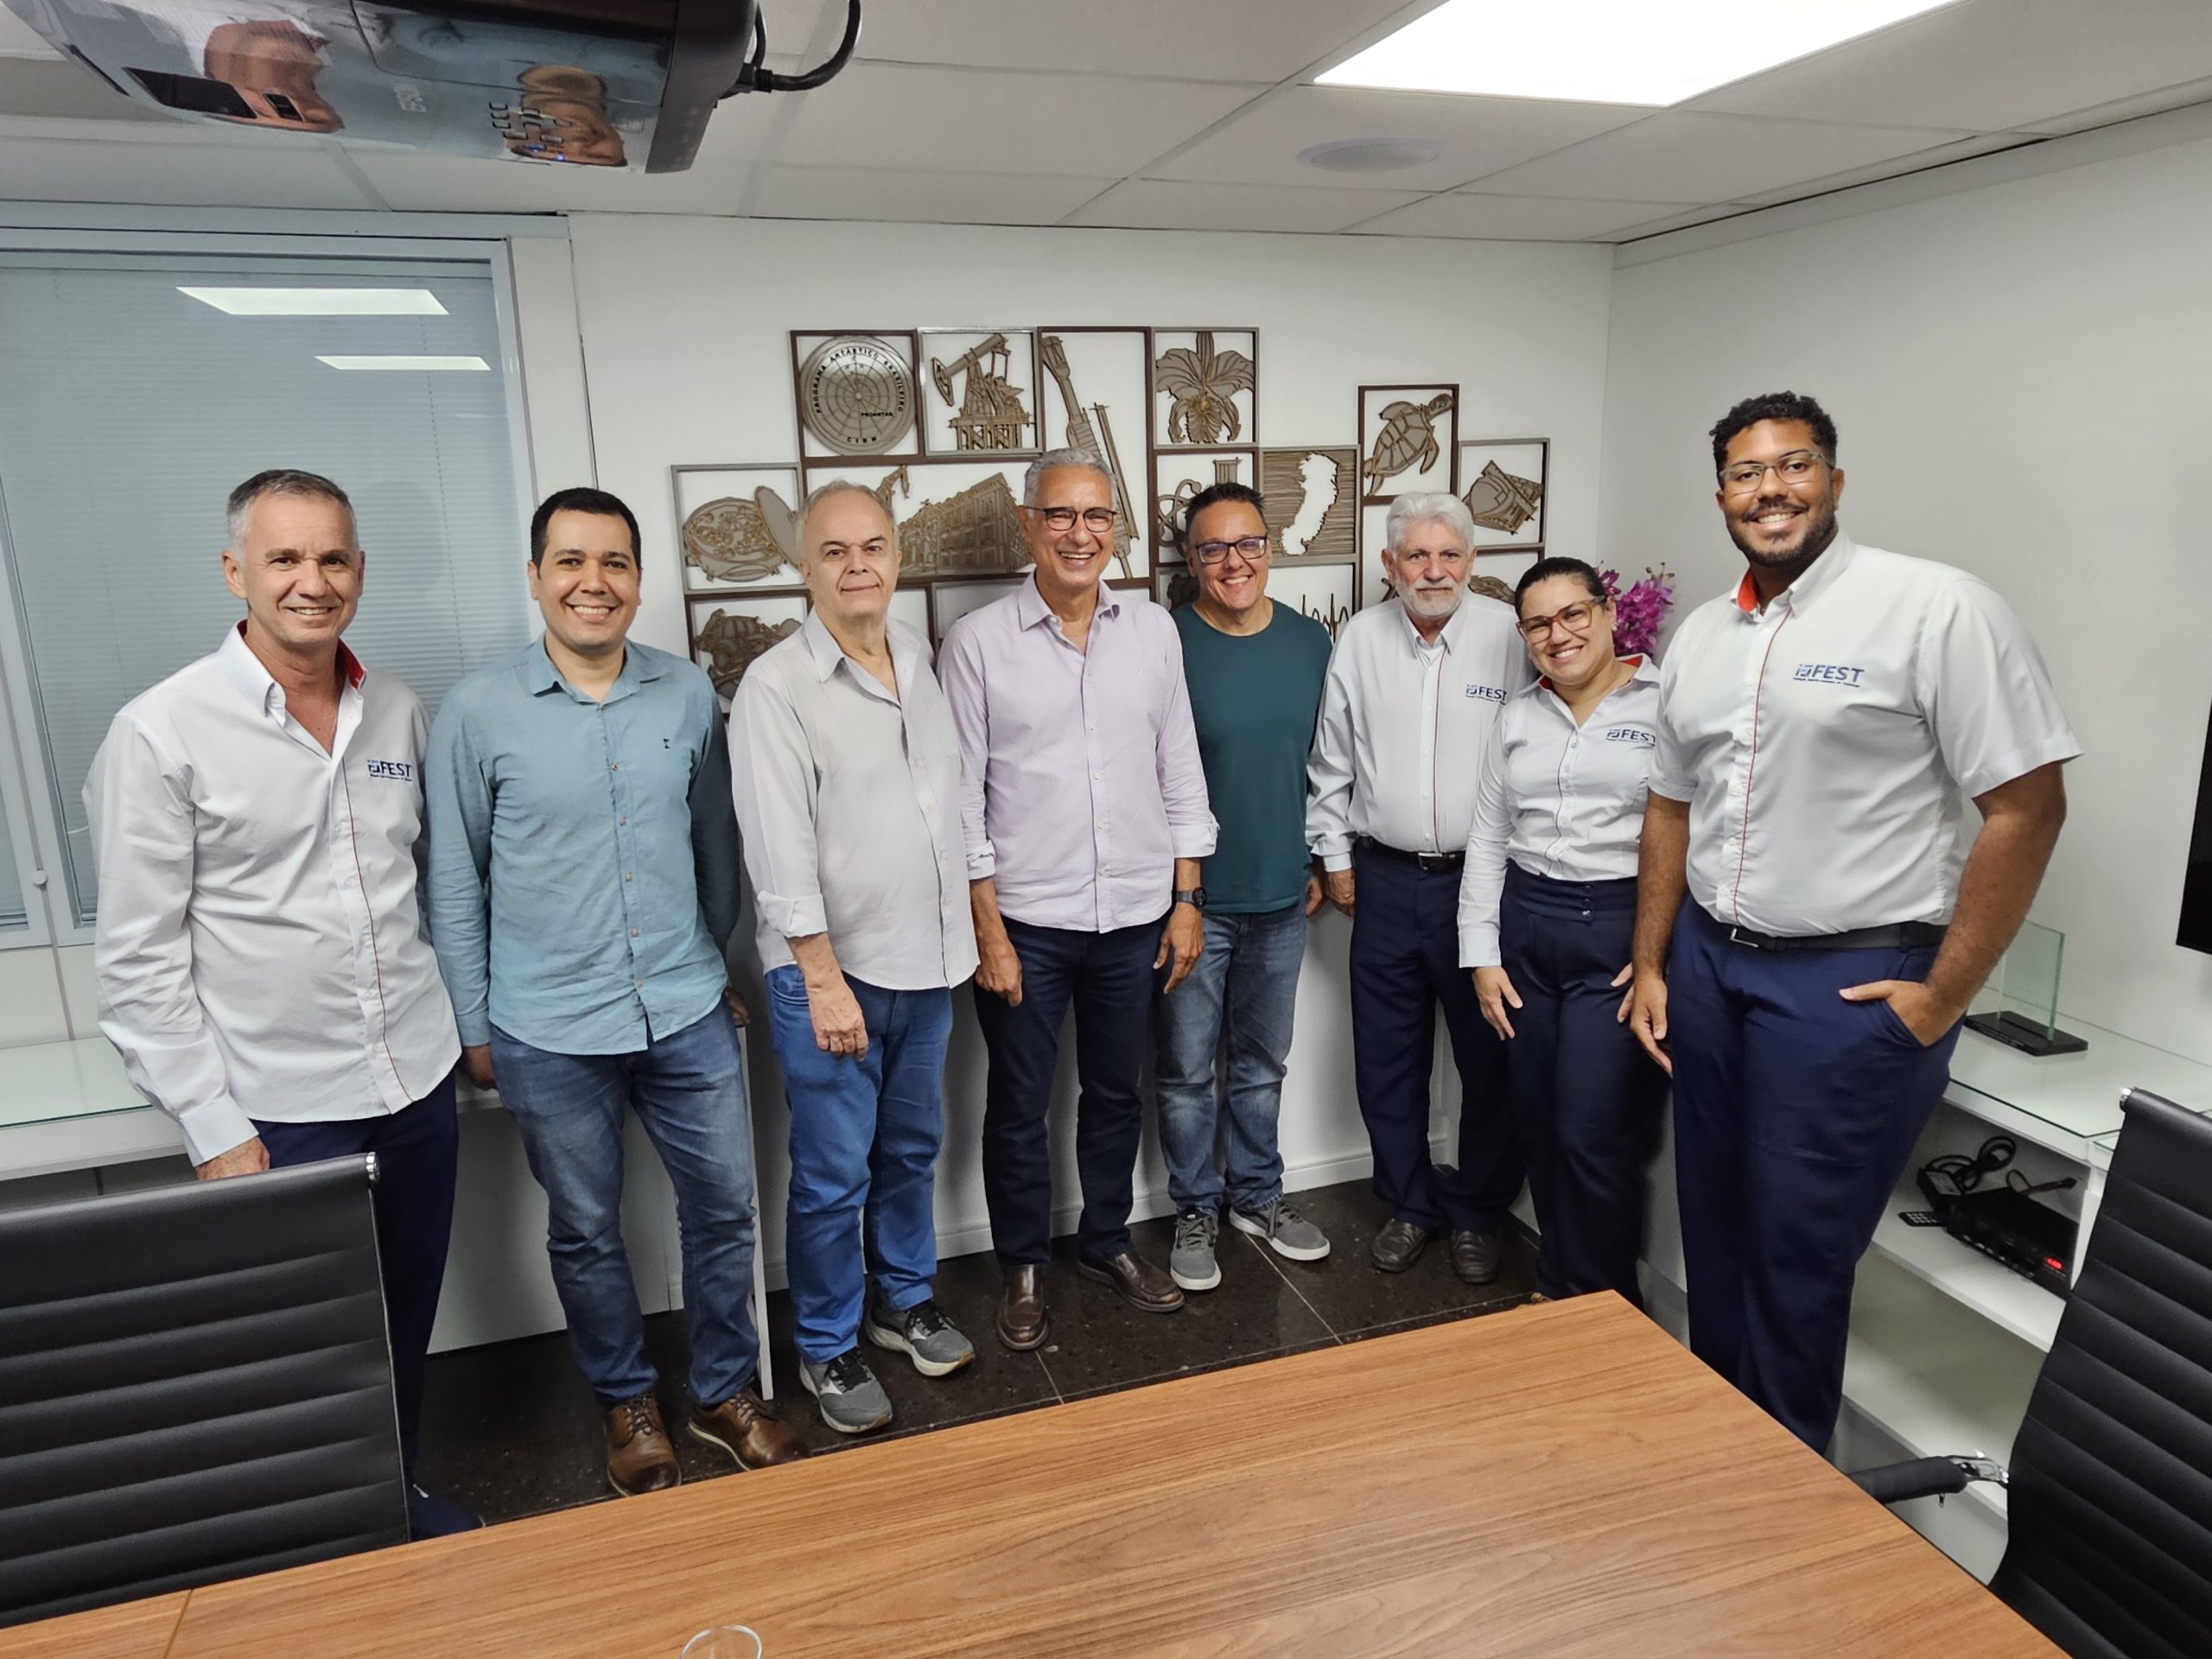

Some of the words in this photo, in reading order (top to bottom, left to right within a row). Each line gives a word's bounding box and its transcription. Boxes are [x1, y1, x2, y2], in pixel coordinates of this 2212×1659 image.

[813, 365, 826, 414] PROGRAMA
[884, 360, 905, 412] BRASILEIRO
[1811, 664, 1865, 683] FEST
[380, 760, 412, 778] FEST
